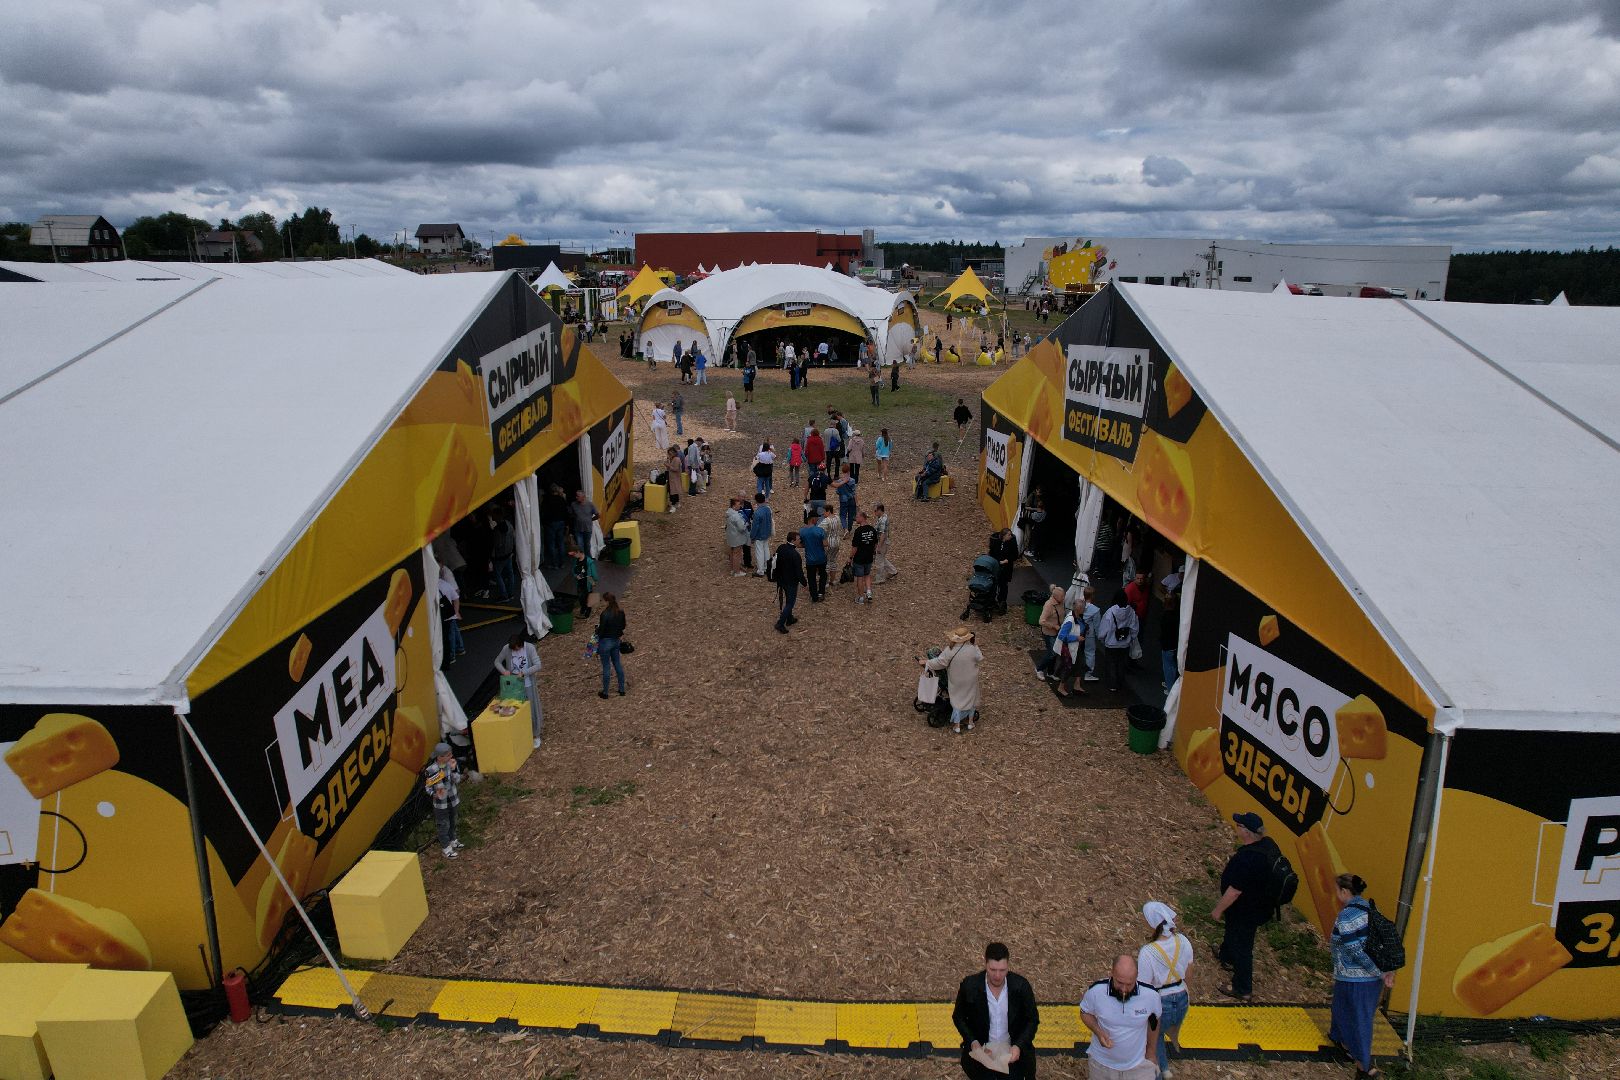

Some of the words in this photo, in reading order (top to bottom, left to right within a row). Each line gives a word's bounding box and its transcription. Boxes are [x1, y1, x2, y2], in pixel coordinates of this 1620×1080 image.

[488, 331, 550, 409] СЫРНЫЙ
[1068, 354, 1143, 403] СЫРНЫЙ
[499, 394, 549, 453] ФЕСТИВАЛЬ
[605, 431, 623, 472] СЫР
[987, 435, 1006, 467] ПИВО
[1068, 409, 1133, 449] ФЕСТИВАЛЬ
[293, 636, 386, 772] МЕД
[1228, 652, 1331, 758] МЯСО
[310, 709, 392, 839] ЗДЕСЬ!
[1224, 731, 1311, 824] ЗДЕСЬ!
